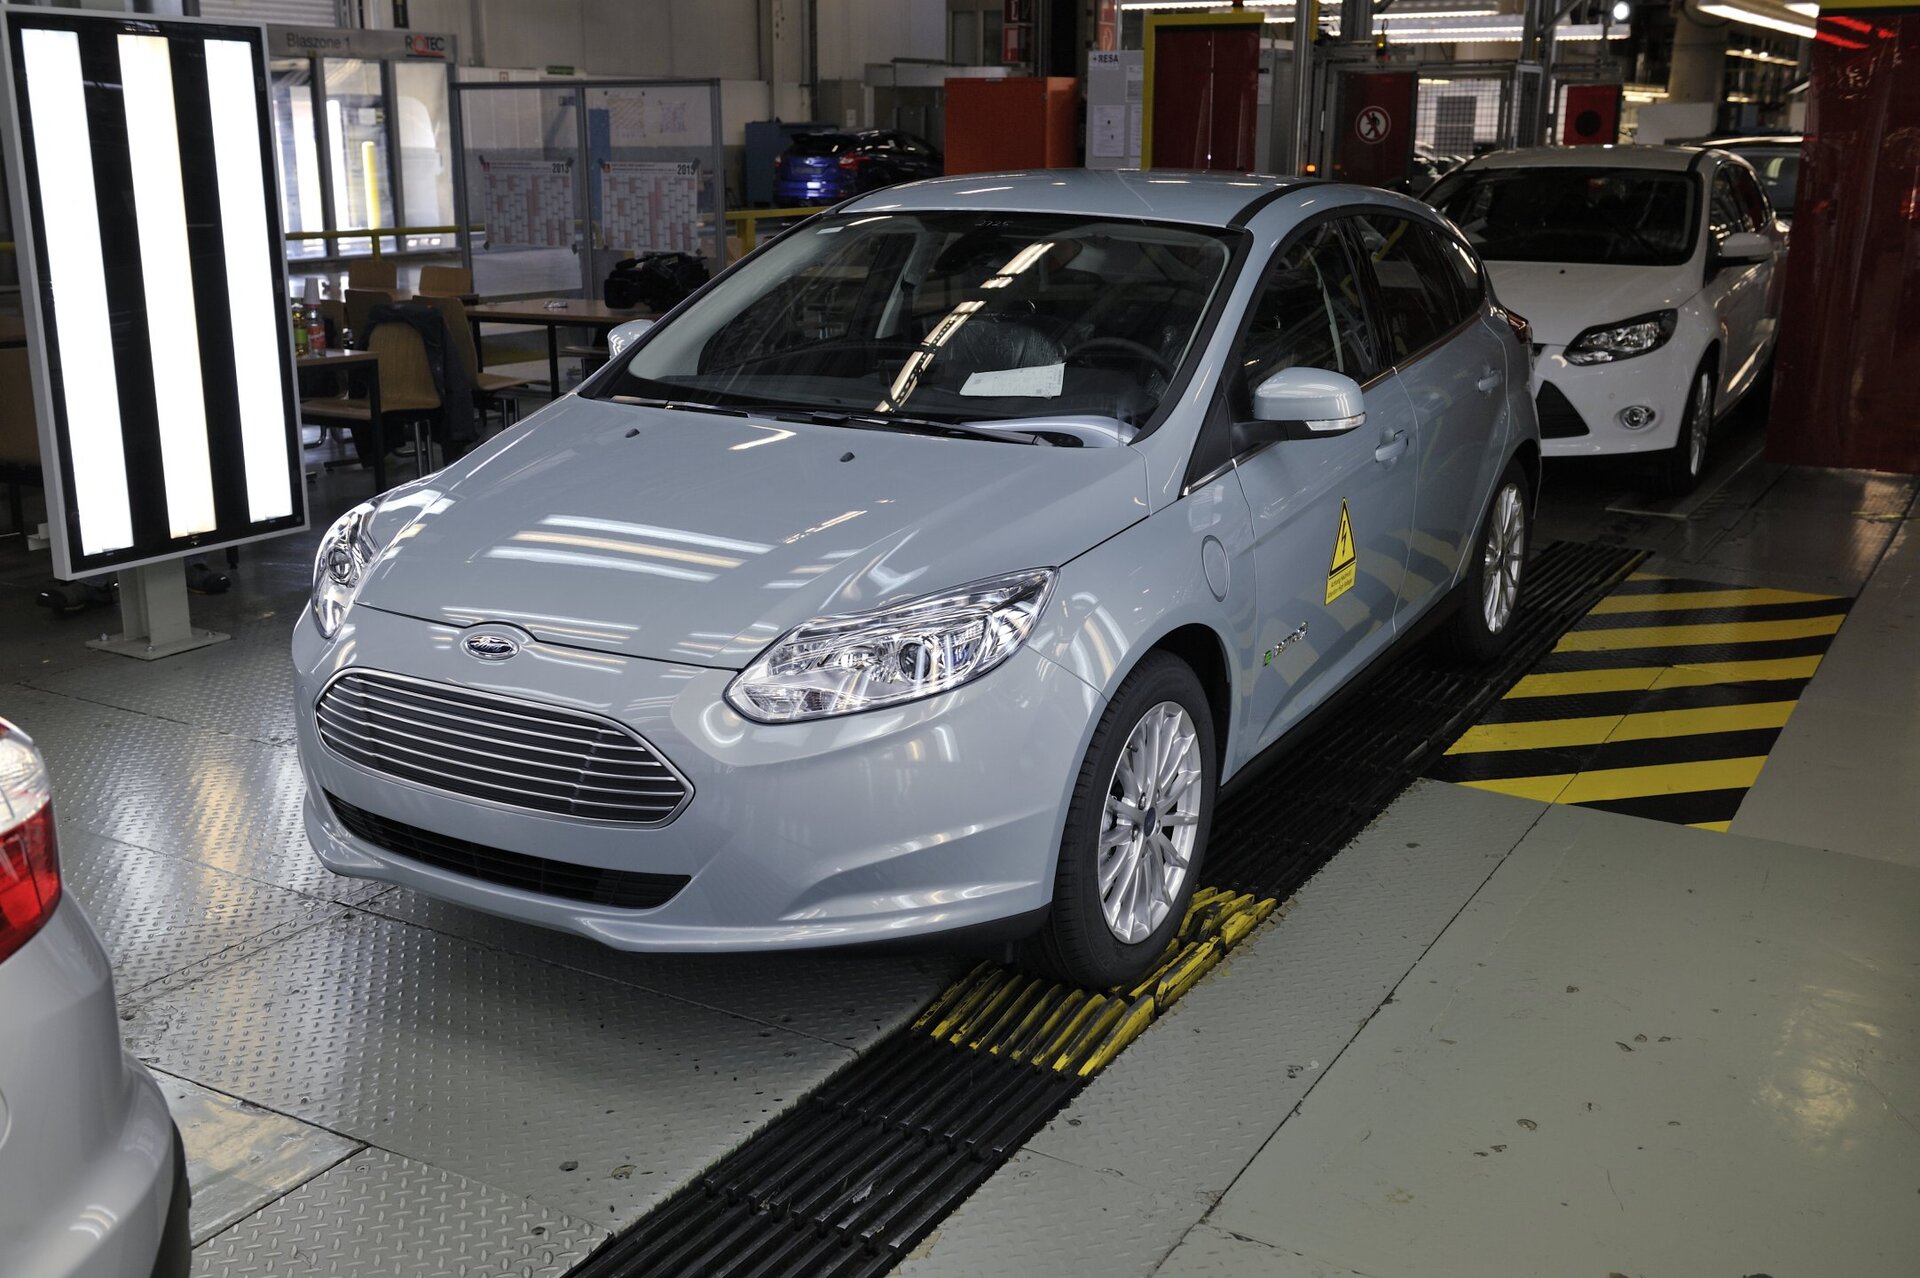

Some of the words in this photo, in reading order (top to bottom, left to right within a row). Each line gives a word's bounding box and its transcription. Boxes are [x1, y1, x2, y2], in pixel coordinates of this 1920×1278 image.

[286, 32, 341, 49] Blaszone
[344, 37, 350, 48] 1
[405, 35, 445, 51] ROTEC
